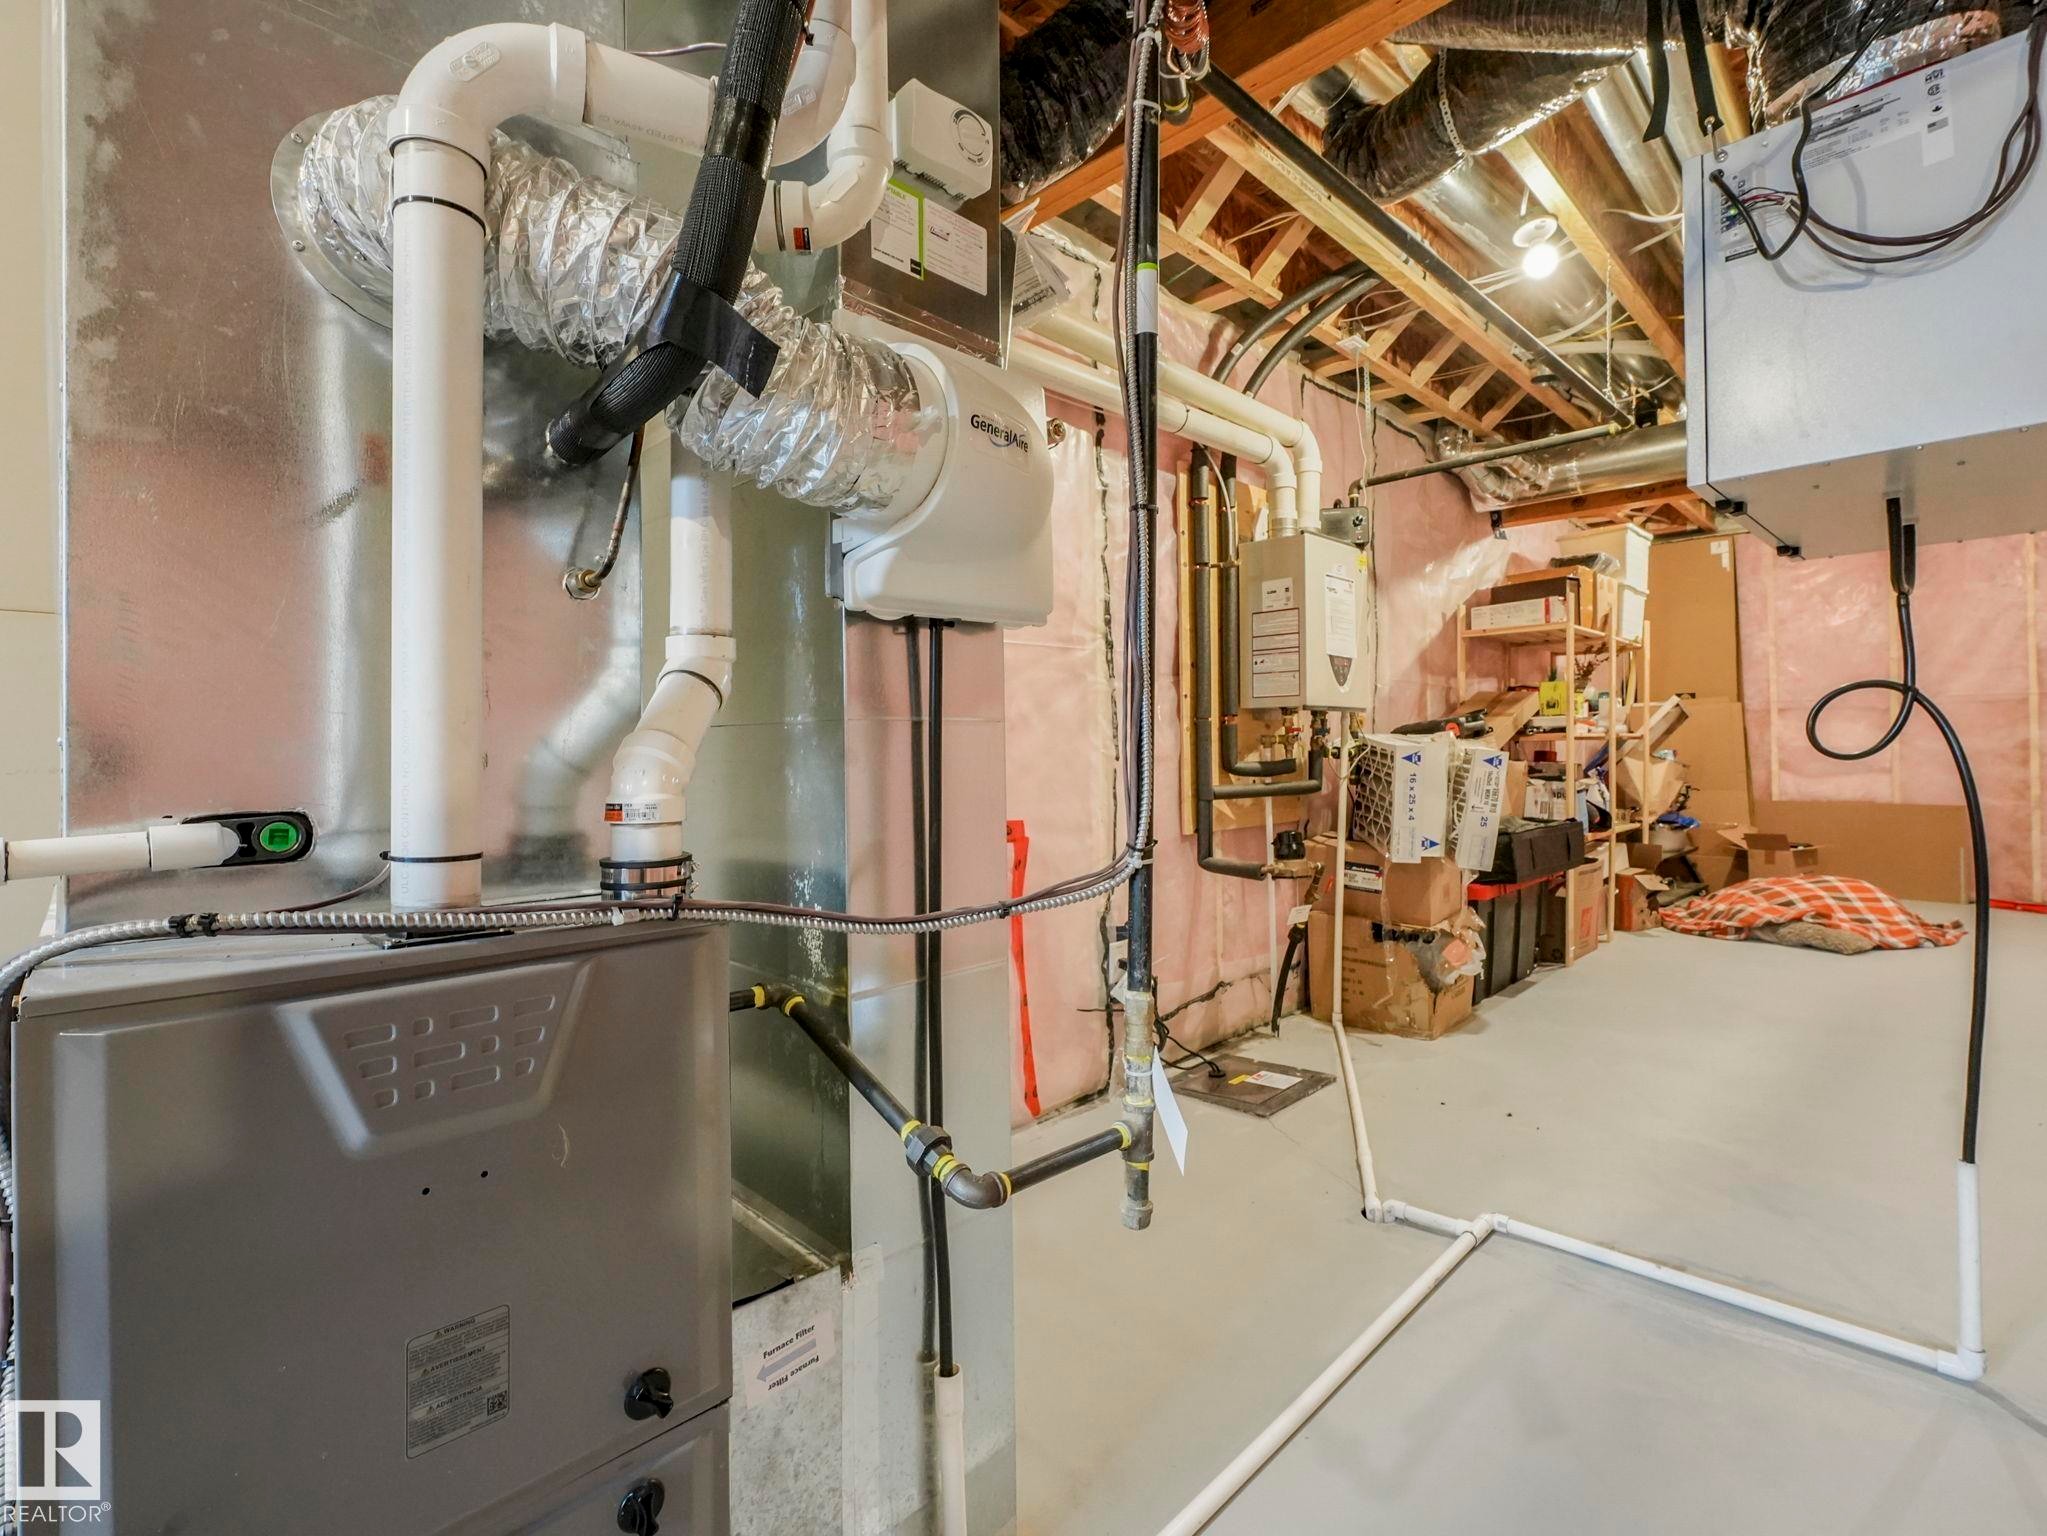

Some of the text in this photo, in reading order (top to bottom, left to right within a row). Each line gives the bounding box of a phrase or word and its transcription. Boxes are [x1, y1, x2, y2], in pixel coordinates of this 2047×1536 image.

[970, 414, 1029, 452] GeneralAire
[1409, 772, 1417, 783] 16
[1408, 794, 1416, 805] 25
[1479, 815, 1489, 828] 25
[443, 1318, 476, 1335] WARNING
[762, 1324, 815, 1359] Furnace Filter
[430, 1346, 486, 1372] AVERTISSEMENT
[768, 1355, 819, 1391] Furnace Filter
[435, 1385, 483, 1409] ADVERTENCIA
